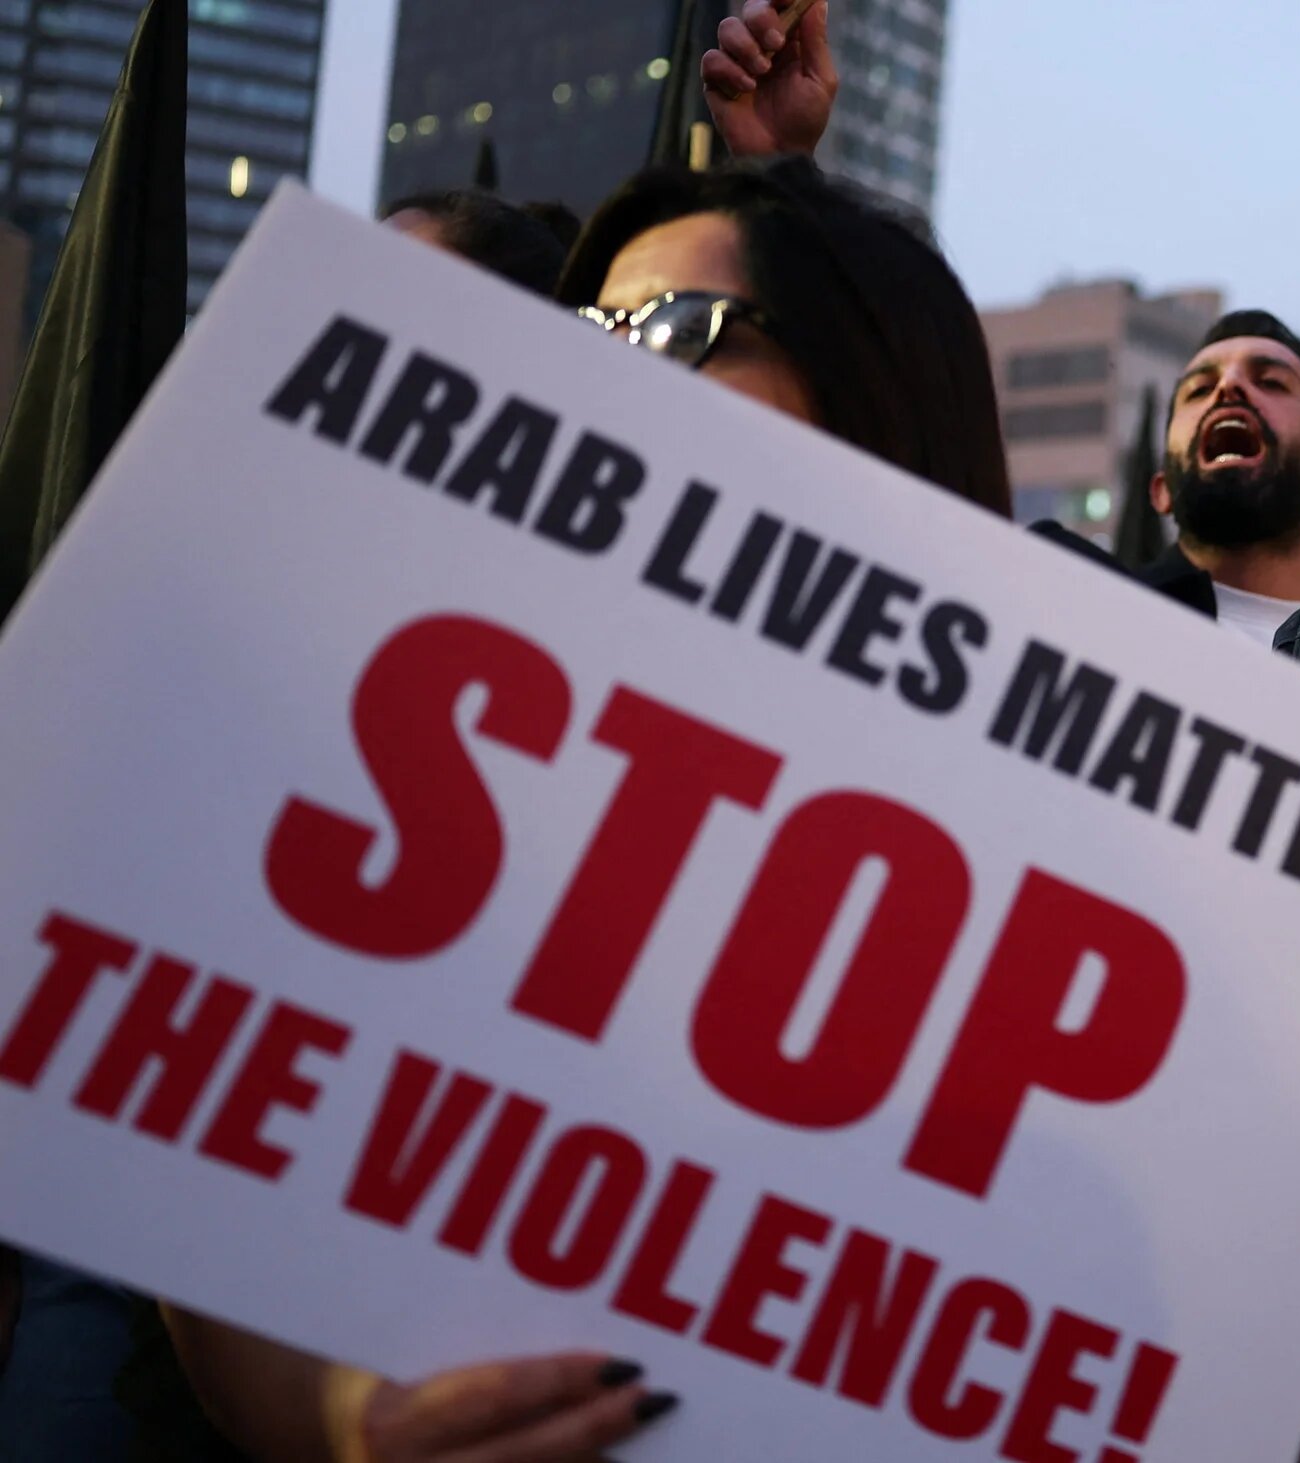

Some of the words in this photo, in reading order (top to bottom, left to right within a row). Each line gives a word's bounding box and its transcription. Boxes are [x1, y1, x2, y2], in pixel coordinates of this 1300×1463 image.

[265, 315, 646, 555] ARAB
[642, 480, 989, 716] LIVES
[264, 612, 1188, 1198] STOP
[0, 910, 352, 1181] THE
[343, 1043, 1179, 1463] VIOLENCE!
